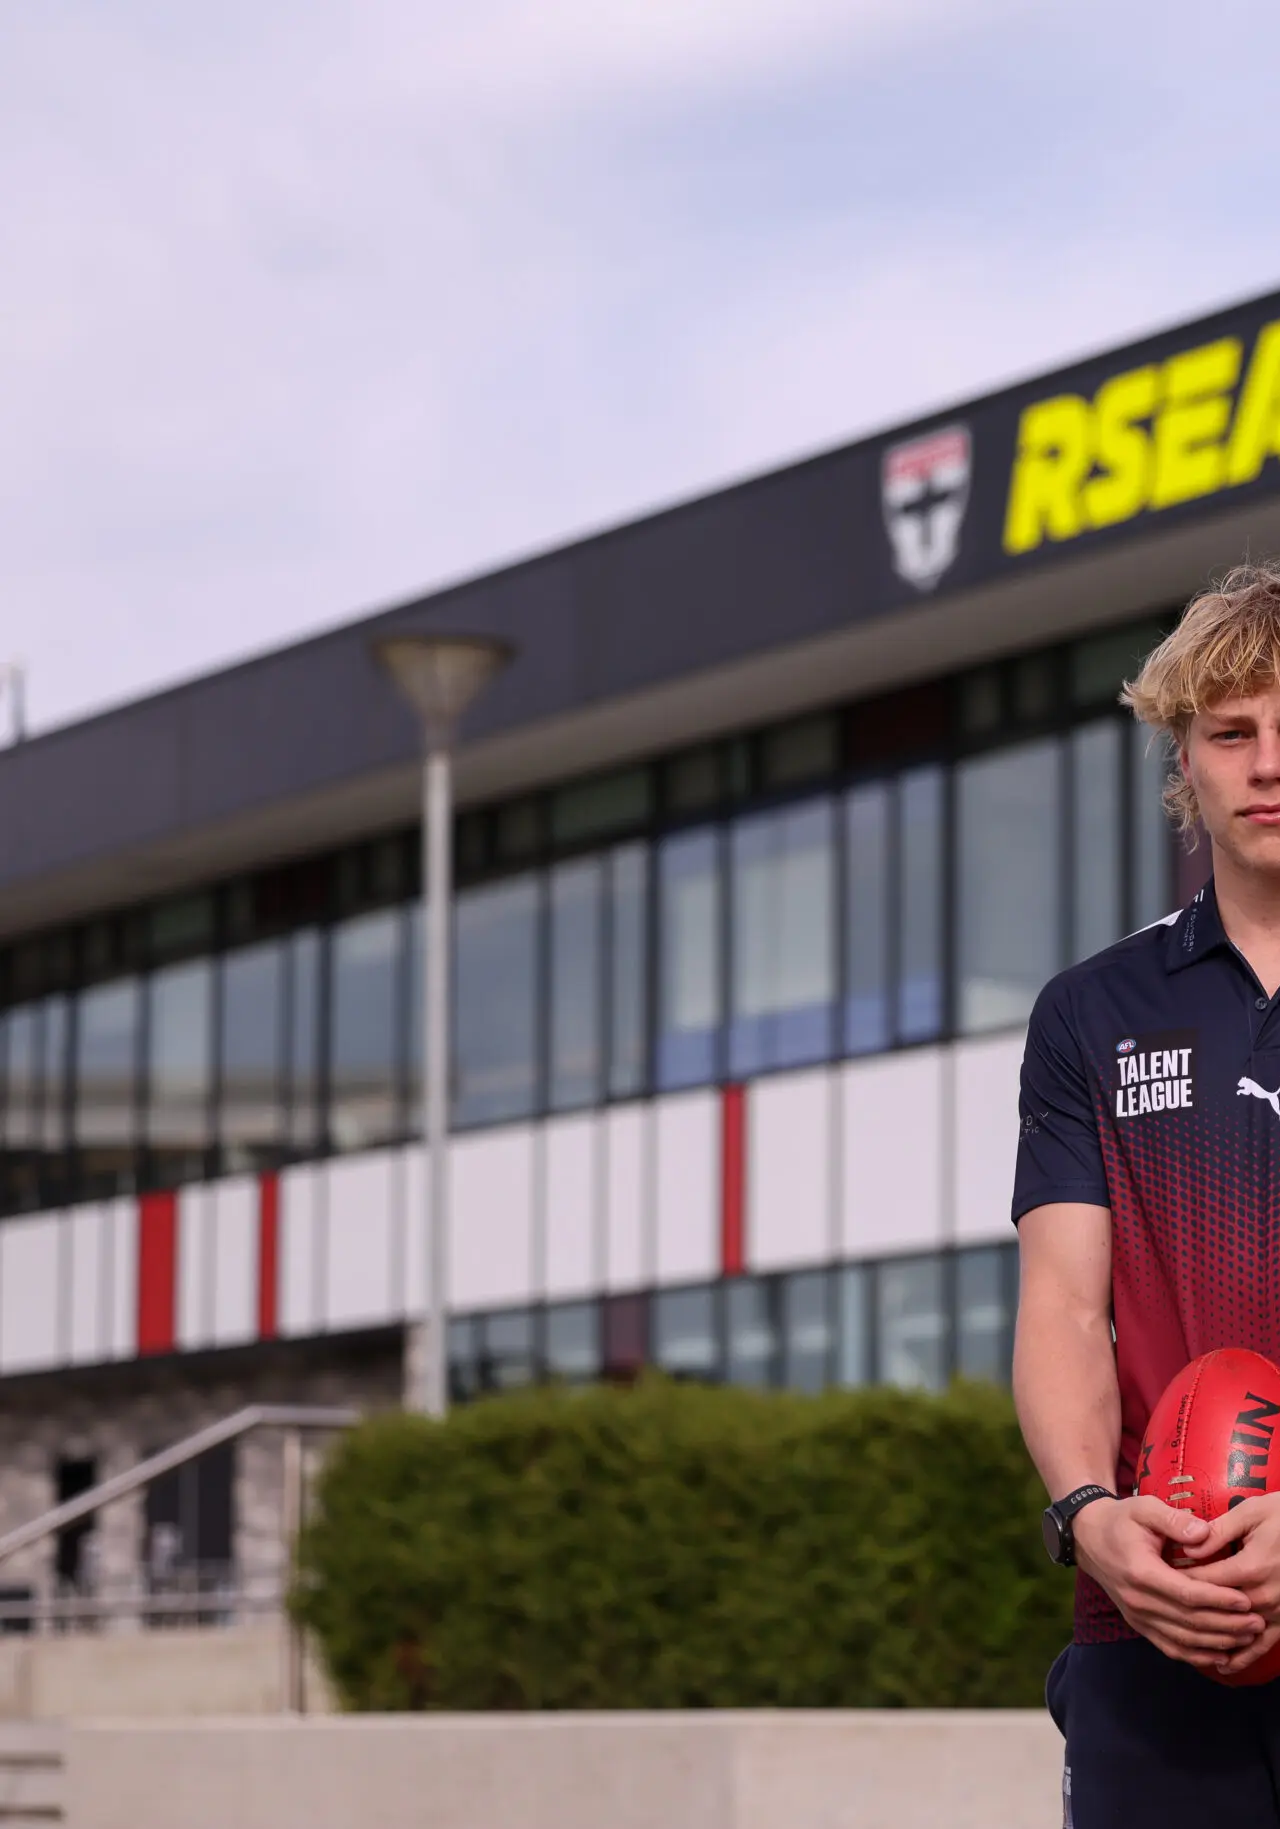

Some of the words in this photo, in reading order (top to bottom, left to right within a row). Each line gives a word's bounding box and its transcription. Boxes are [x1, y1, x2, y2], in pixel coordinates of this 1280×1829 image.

[1118, 1041, 1134, 1051] AFL
[1117, 1048, 1192, 1087] TALENT
[1116, 1078, 1193, 1117] LEAGUE
